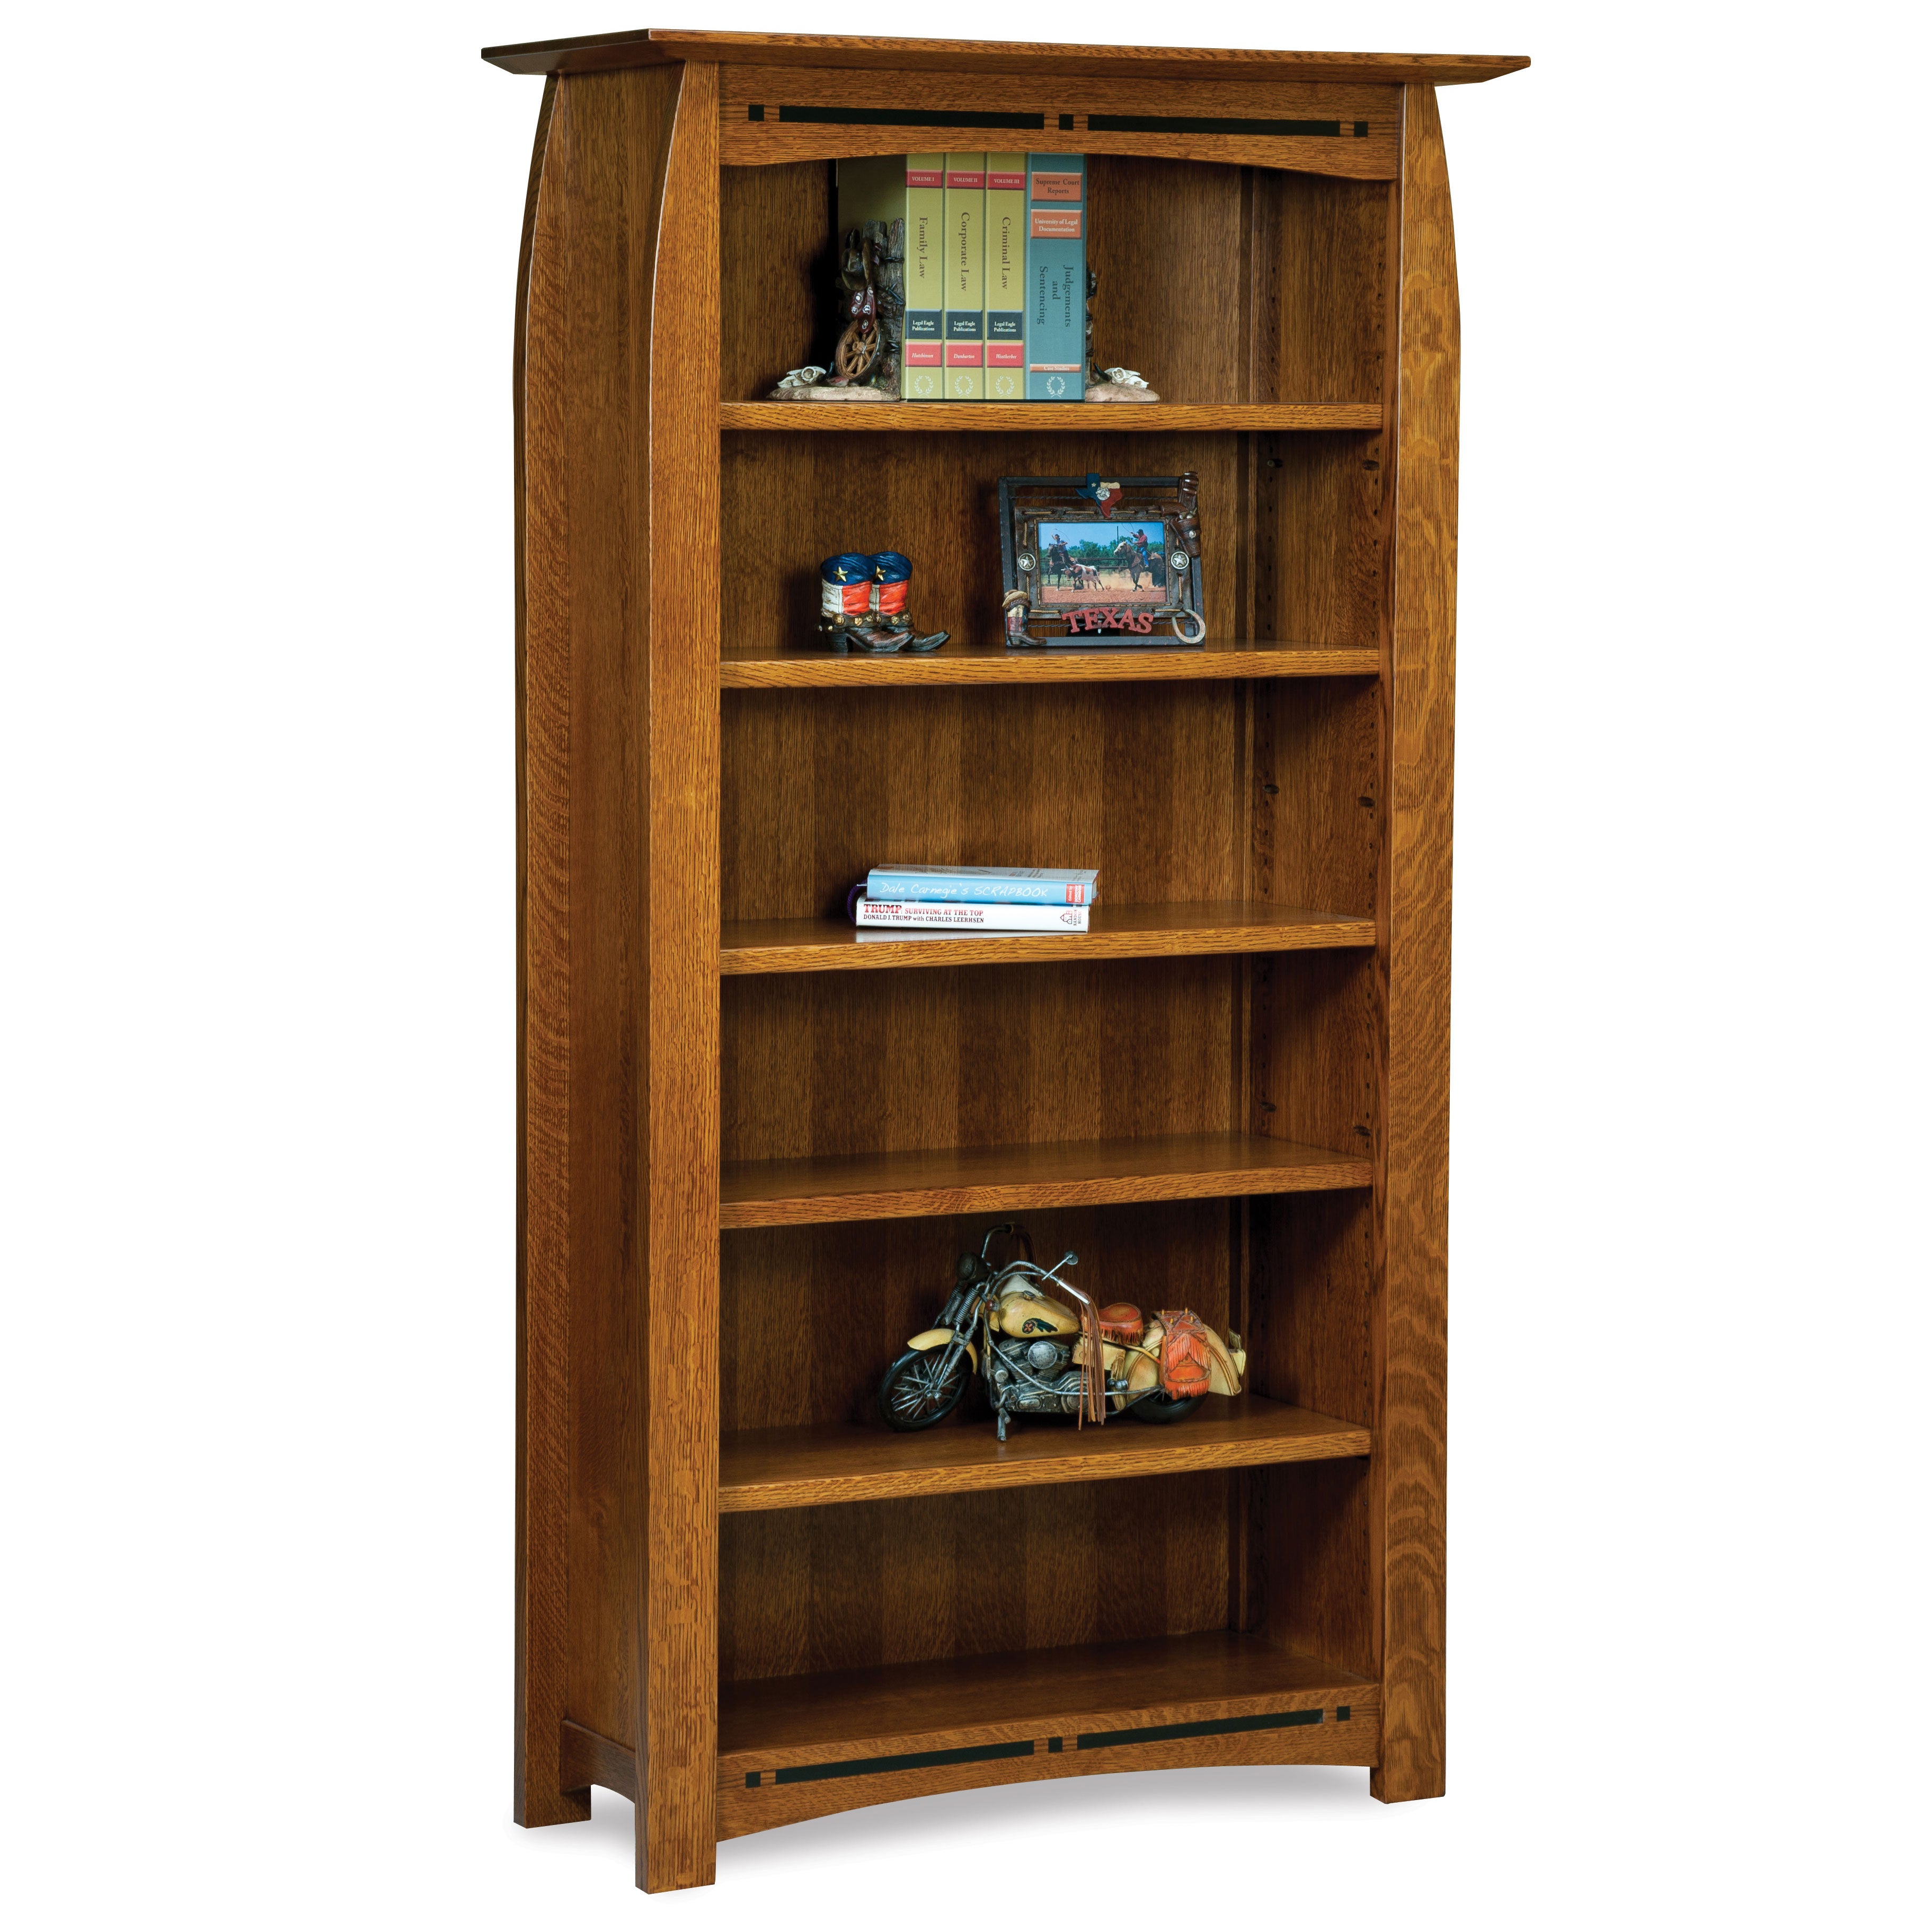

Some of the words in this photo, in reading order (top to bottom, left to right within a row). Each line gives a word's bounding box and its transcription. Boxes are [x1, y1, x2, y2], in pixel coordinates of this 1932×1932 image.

[1036, 178, 1060, 187] Supreme
[917, 217, 928, 253] Family
[959, 212, 970, 266] Corporate
[1002, 217, 1011, 264] Criminal
[961, 269, 969, 291] Law
[1002, 267, 1010, 289] Law
[1052, 281, 1061, 300] and
[1036, 266, 1048, 325] Sentencing
[1062, 265, 1074, 327] Judgements
[1062, 607, 1154, 634] TEXAS
[880, 882, 905, 893] Dale
[910, 883, 968, 898] Carnegie's
[974, 886, 1049, 897] SCRAPBOOK
